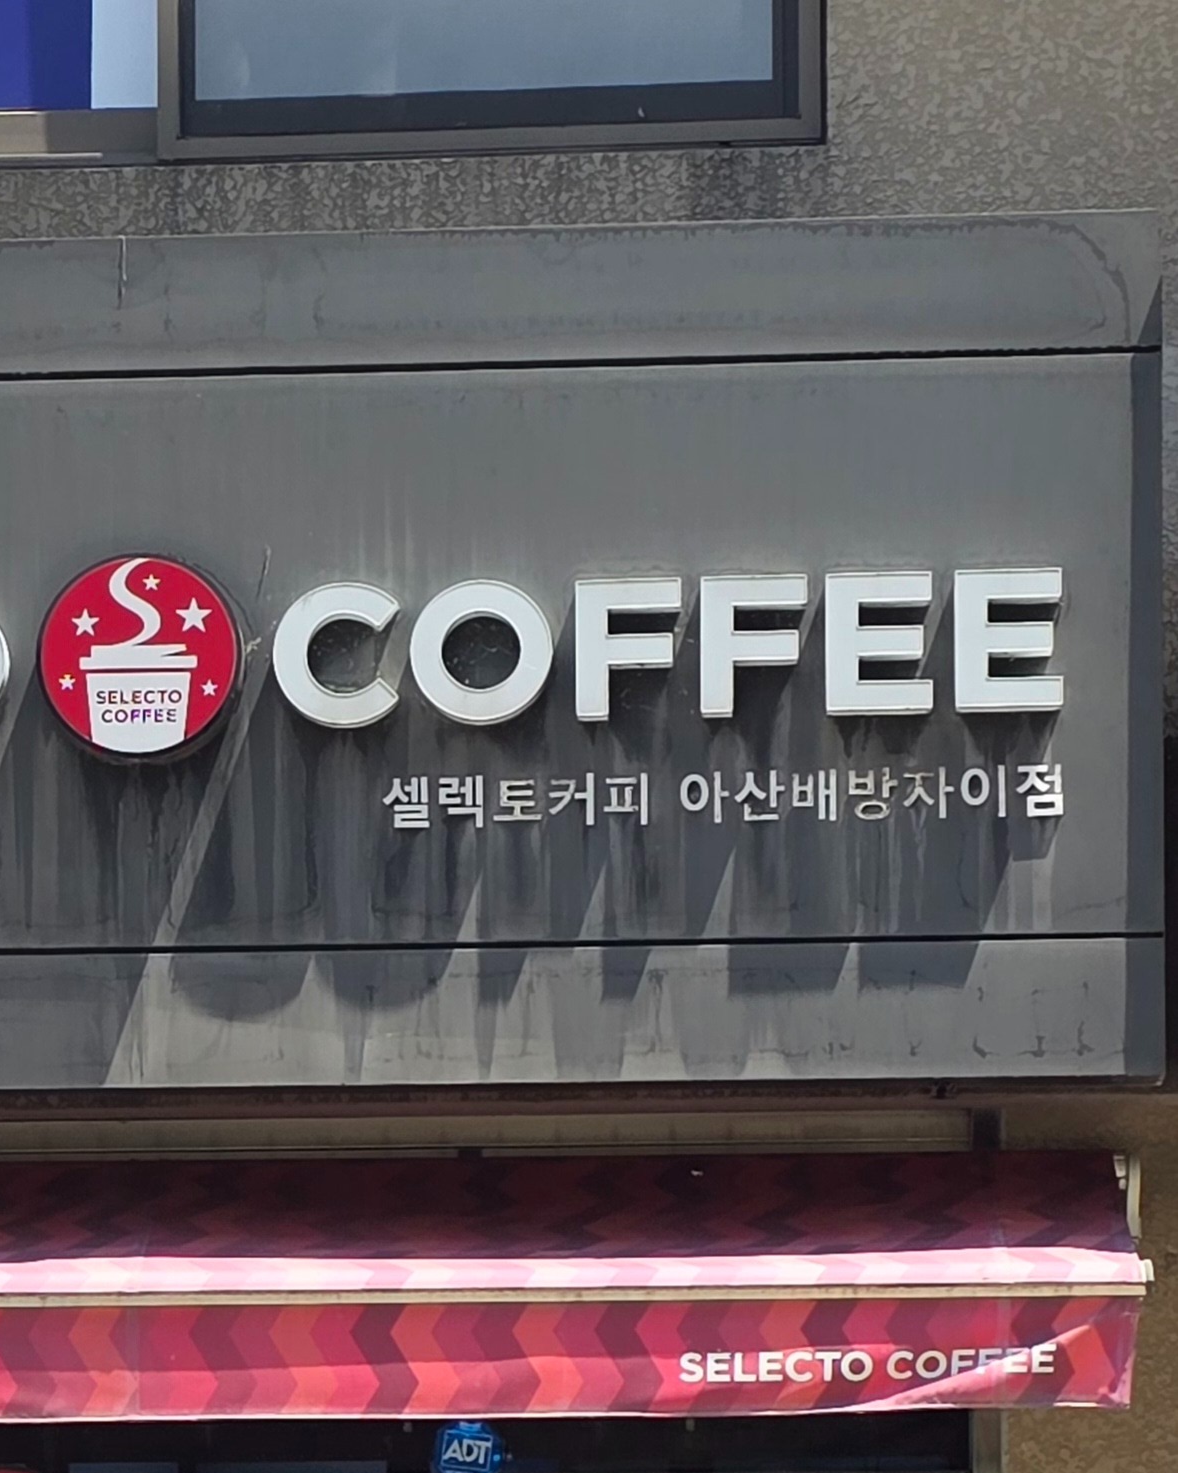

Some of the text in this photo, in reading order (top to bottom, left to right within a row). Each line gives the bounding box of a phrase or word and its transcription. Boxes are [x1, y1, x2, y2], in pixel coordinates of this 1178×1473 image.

[273, 568, 1063, 728] COFFEE
[96, 689, 182, 704] SELECTO
[101, 708, 177, 723] COFFEE
[382, 763, 1065, 829] 셀렉토커피 아산배방자이점
[679, 1343, 1057, 1382] SELECTO COFFEE
[442, 1438, 492, 1465] ADT
